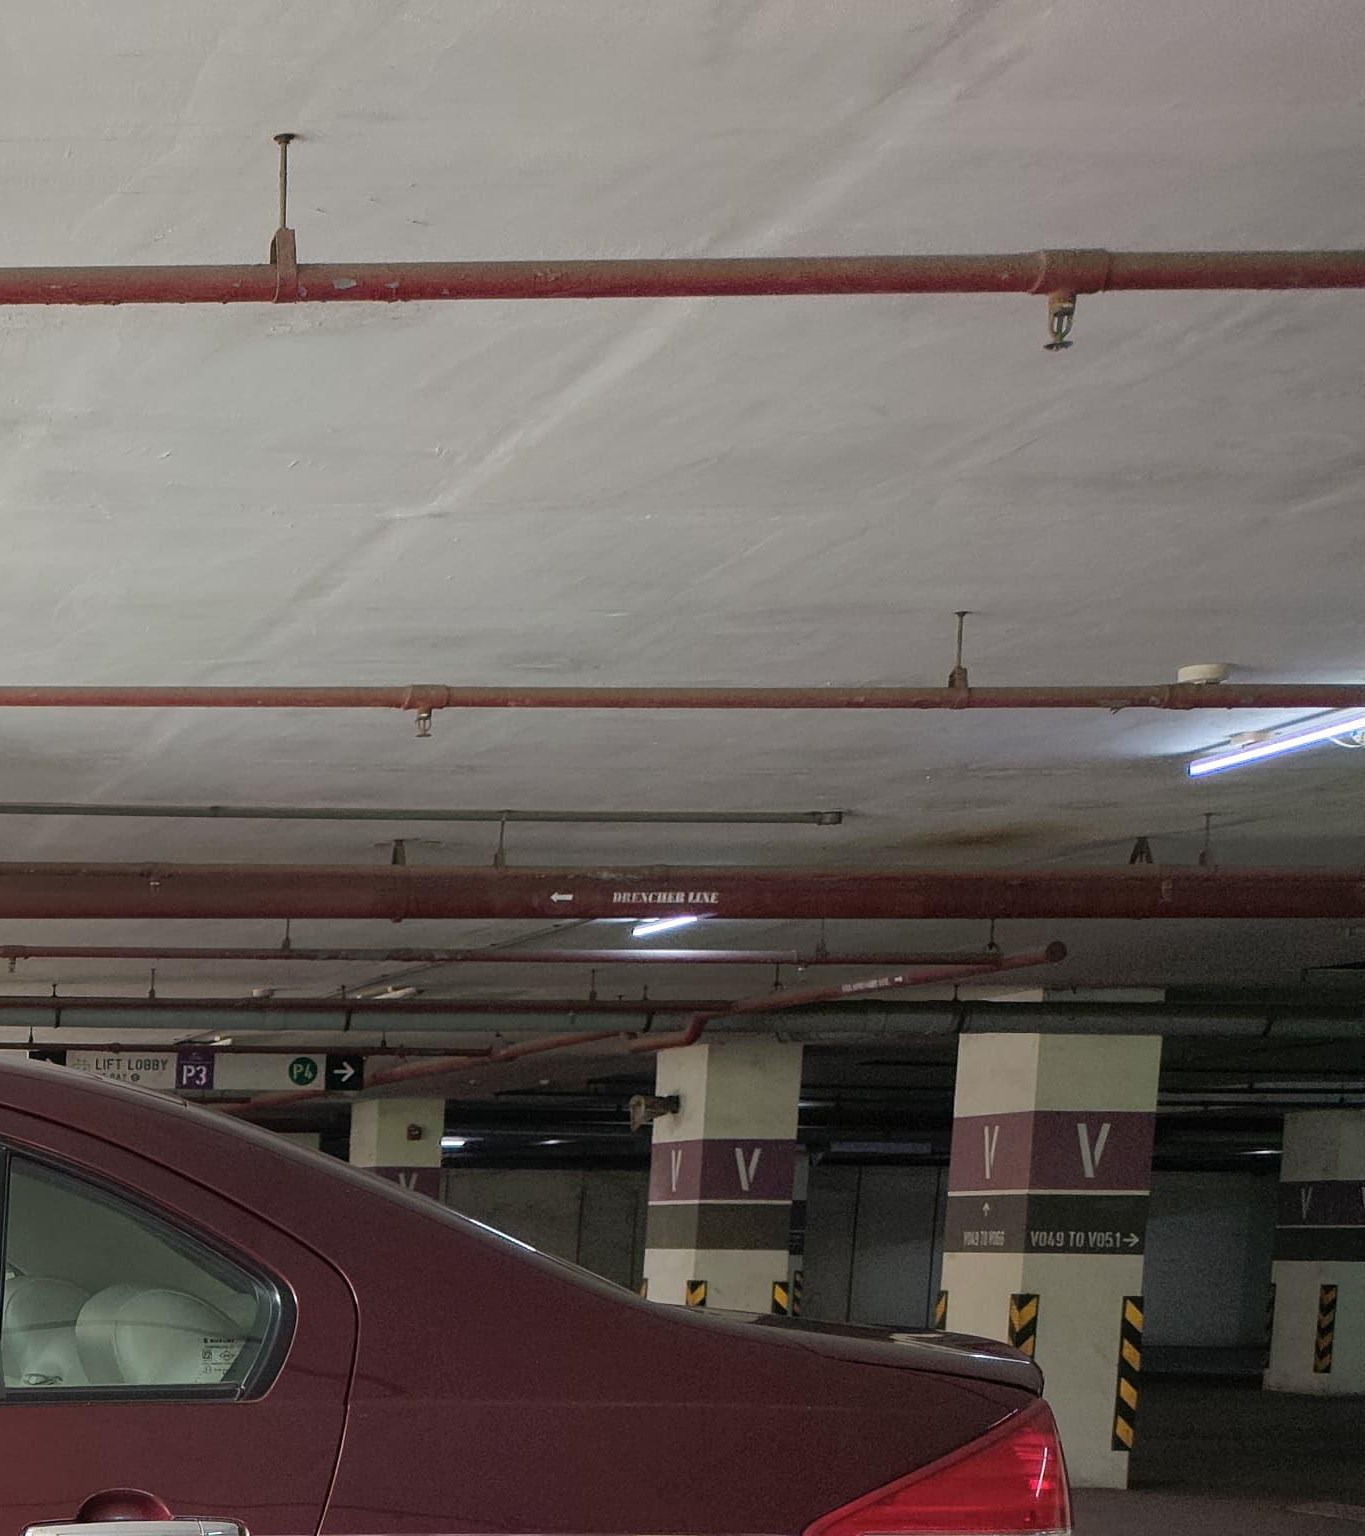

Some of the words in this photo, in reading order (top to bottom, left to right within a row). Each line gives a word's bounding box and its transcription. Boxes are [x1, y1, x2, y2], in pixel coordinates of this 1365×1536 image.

[612, 891, 685, 904] DRENCHER
[687, 891, 719, 904] LINE
[95, 1058, 123, 1071] LIFT
[127, 1058, 168, 1071] LOBBY
[182, 1064, 207, 1086] P3
[292, 1062, 314, 1080] P4
[984, 1125, 1000, 1180] V
[1077, 1123, 1111, 1179] V
[671, 1149, 682, 1193] V
[735, 1147, 762, 1192] V
[1300, 1186, 1313, 1219] V
[1030, 1231, 1065, 1247] V049
[1068, 1231, 1085, 1247] TO
[1088, 1231, 1121, 1248] V051
